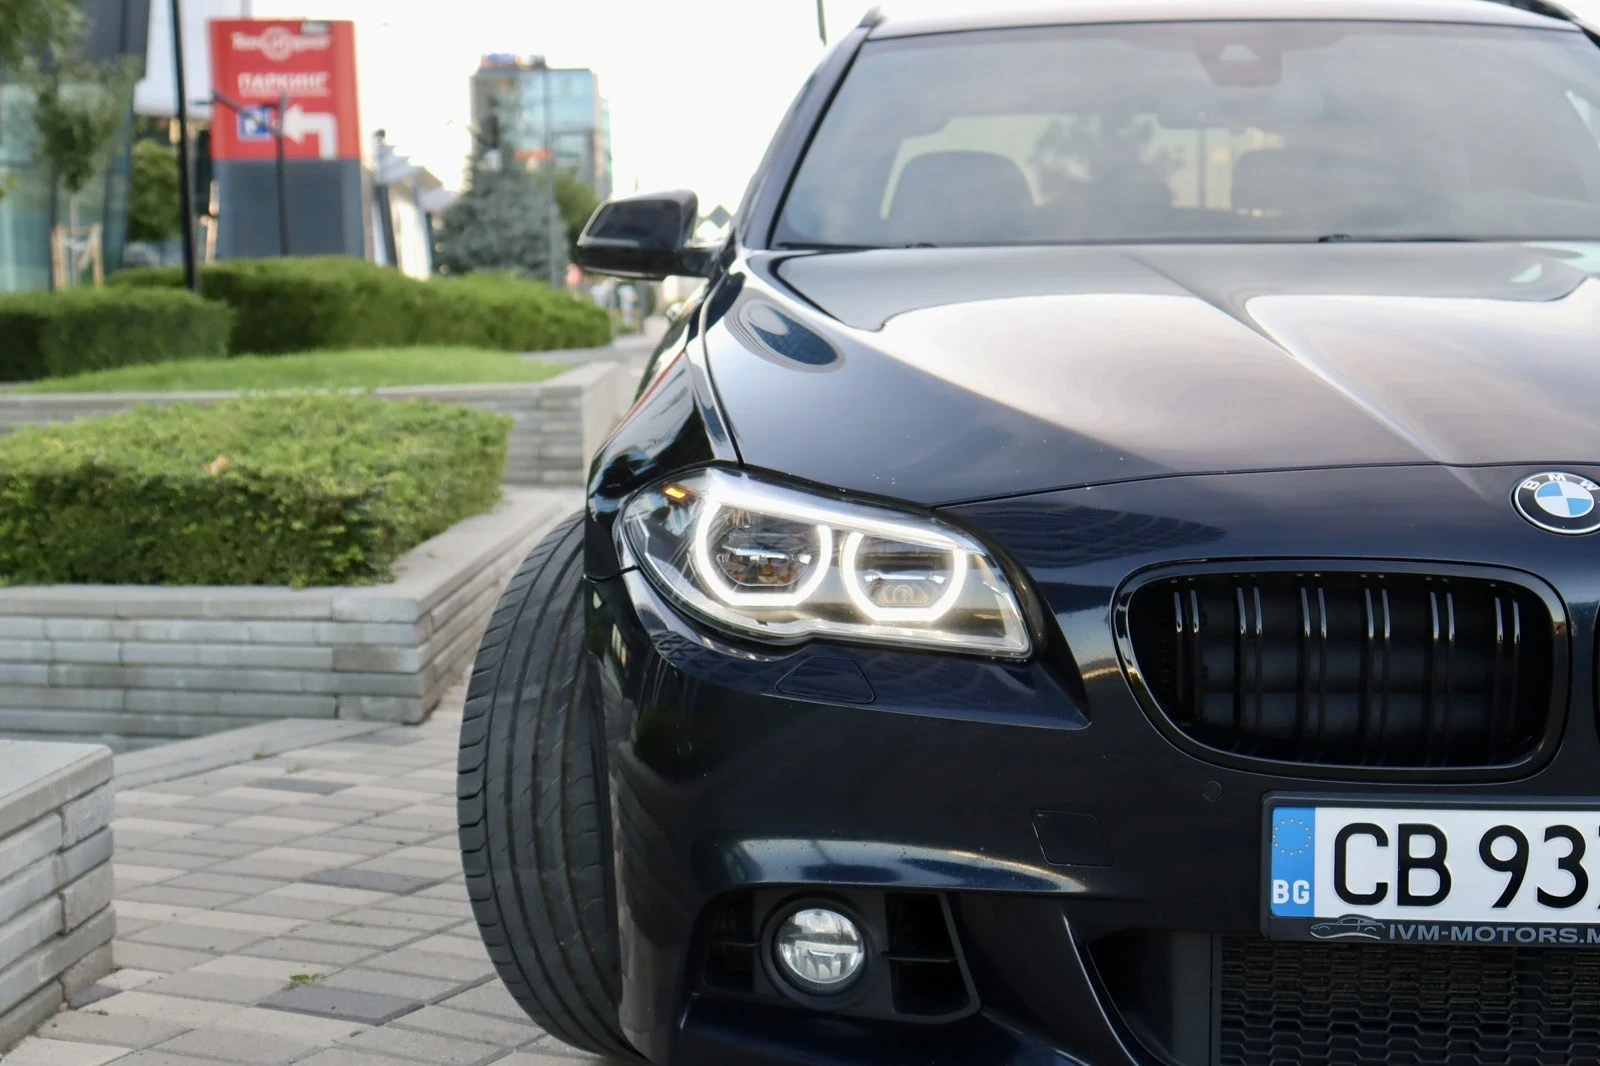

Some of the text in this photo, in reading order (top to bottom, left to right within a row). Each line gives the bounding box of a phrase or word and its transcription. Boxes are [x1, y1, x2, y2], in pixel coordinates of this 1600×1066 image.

[237, 71, 329, 90] ПАРКИНГ
[1521, 473, 1600, 491] BMW
[1333, 822, 1600, 910] CB 93
[1272, 879, 1310, 905] BG
